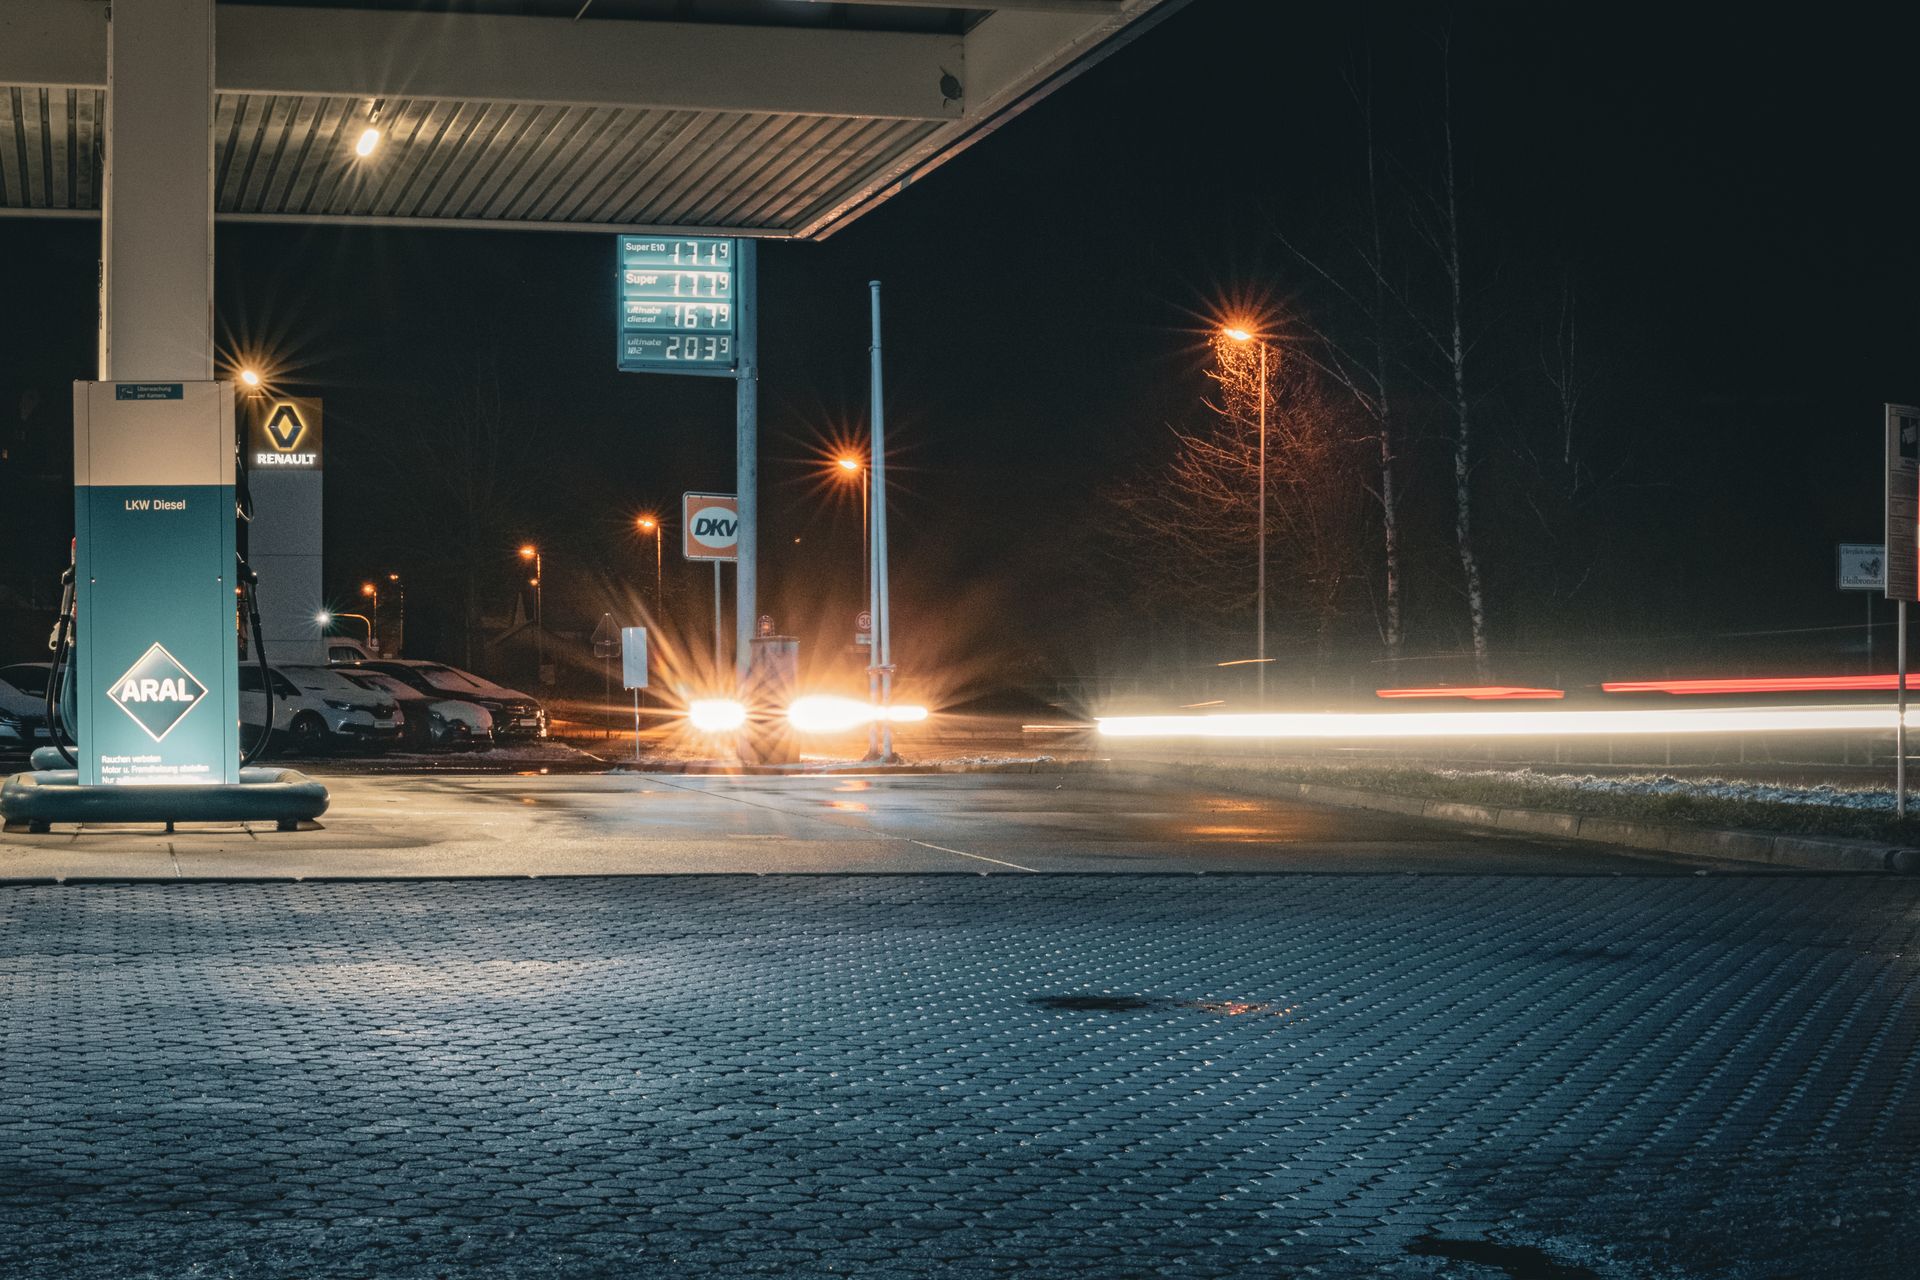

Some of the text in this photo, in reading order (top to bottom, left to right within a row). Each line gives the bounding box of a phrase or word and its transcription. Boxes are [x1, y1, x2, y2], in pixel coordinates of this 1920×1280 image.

[626, 242, 649, 252] Super
[650, 243, 666, 252] E10
[626, 273, 658, 285] Super
[627, 306, 662, 314] ultimate
[628, 338, 662, 346] ultimate
[256, 454, 316, 464] RENAULT
[125, 500, 186, 510] LKW Diesel
[694, 518, 738, 536] DKV
[121, 678, 194, 702] ARAL
[102, 755, 130, 764] Rauchen
[102, 766, 121, 774] Motor
